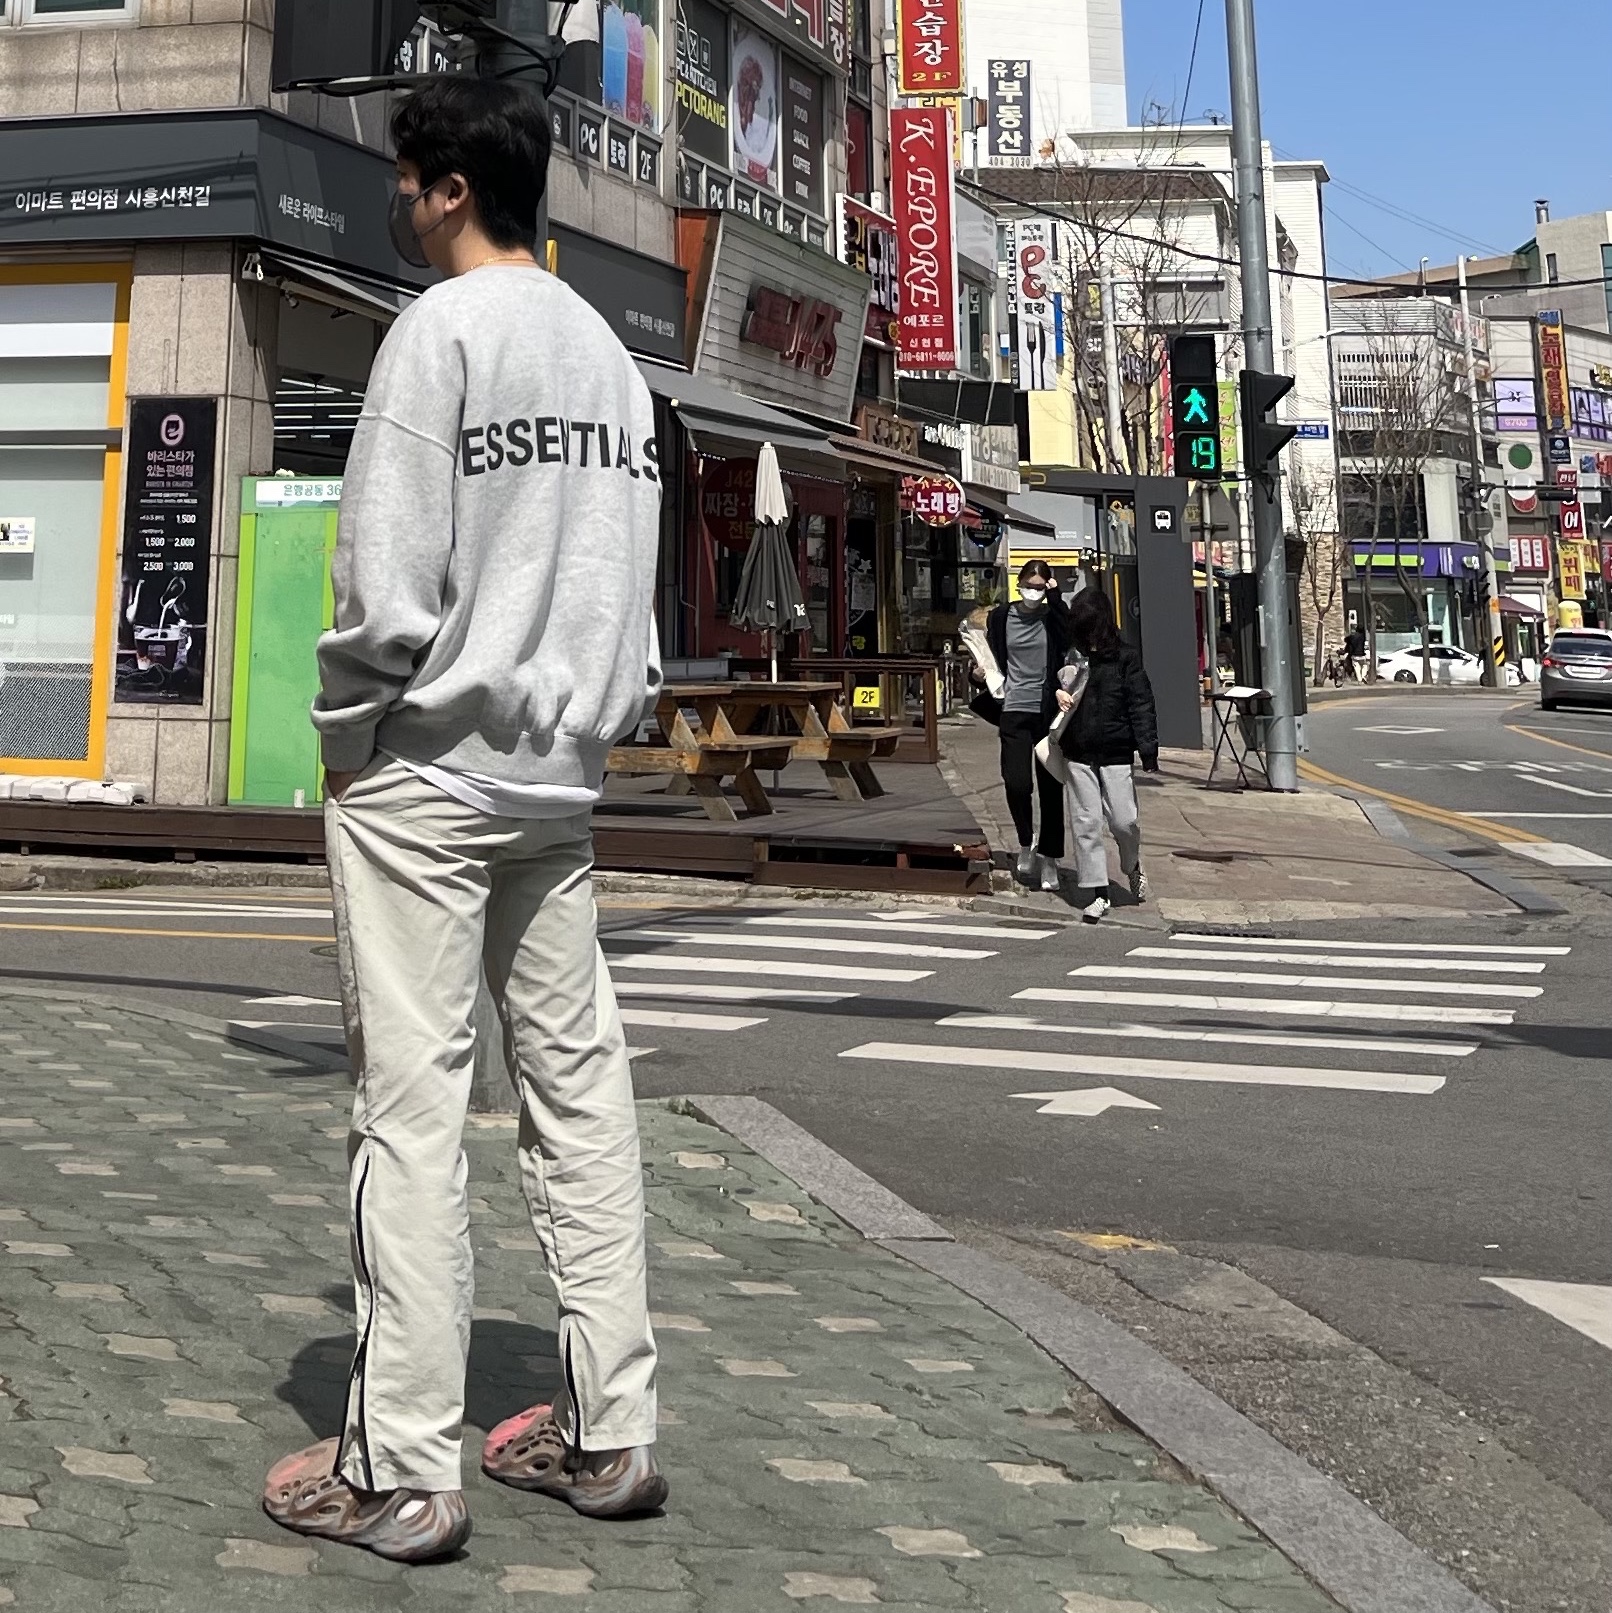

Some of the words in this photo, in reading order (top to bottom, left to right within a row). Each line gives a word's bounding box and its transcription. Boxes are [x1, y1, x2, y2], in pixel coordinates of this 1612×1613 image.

[911, 71, 952, 82] 2F
[990, 61, 1028, 78] 유성
[995, 80, 1024, 154] 부동산
[580, 122, 598, 154] PC
[15, 191, 64, 212] 이마트
[69, 188, 118, 211] 편의점
[124, 185, 211, 208] 시흥신천길
[277, 193, 301, 219] 새로운
[902, 314, 945, 328] 에포르
[146, 450, 196, 463] 바리스타가
[461, 416, 657, 482] ESSENTIALS
[1191, 437, 1215, 470] 19
[146, 464, 166, 478] 있는
[166, 464, 194, 478] 편의점
[915, 491, 960, 514] 노래방
[860, 690, 875, 704] 2F
